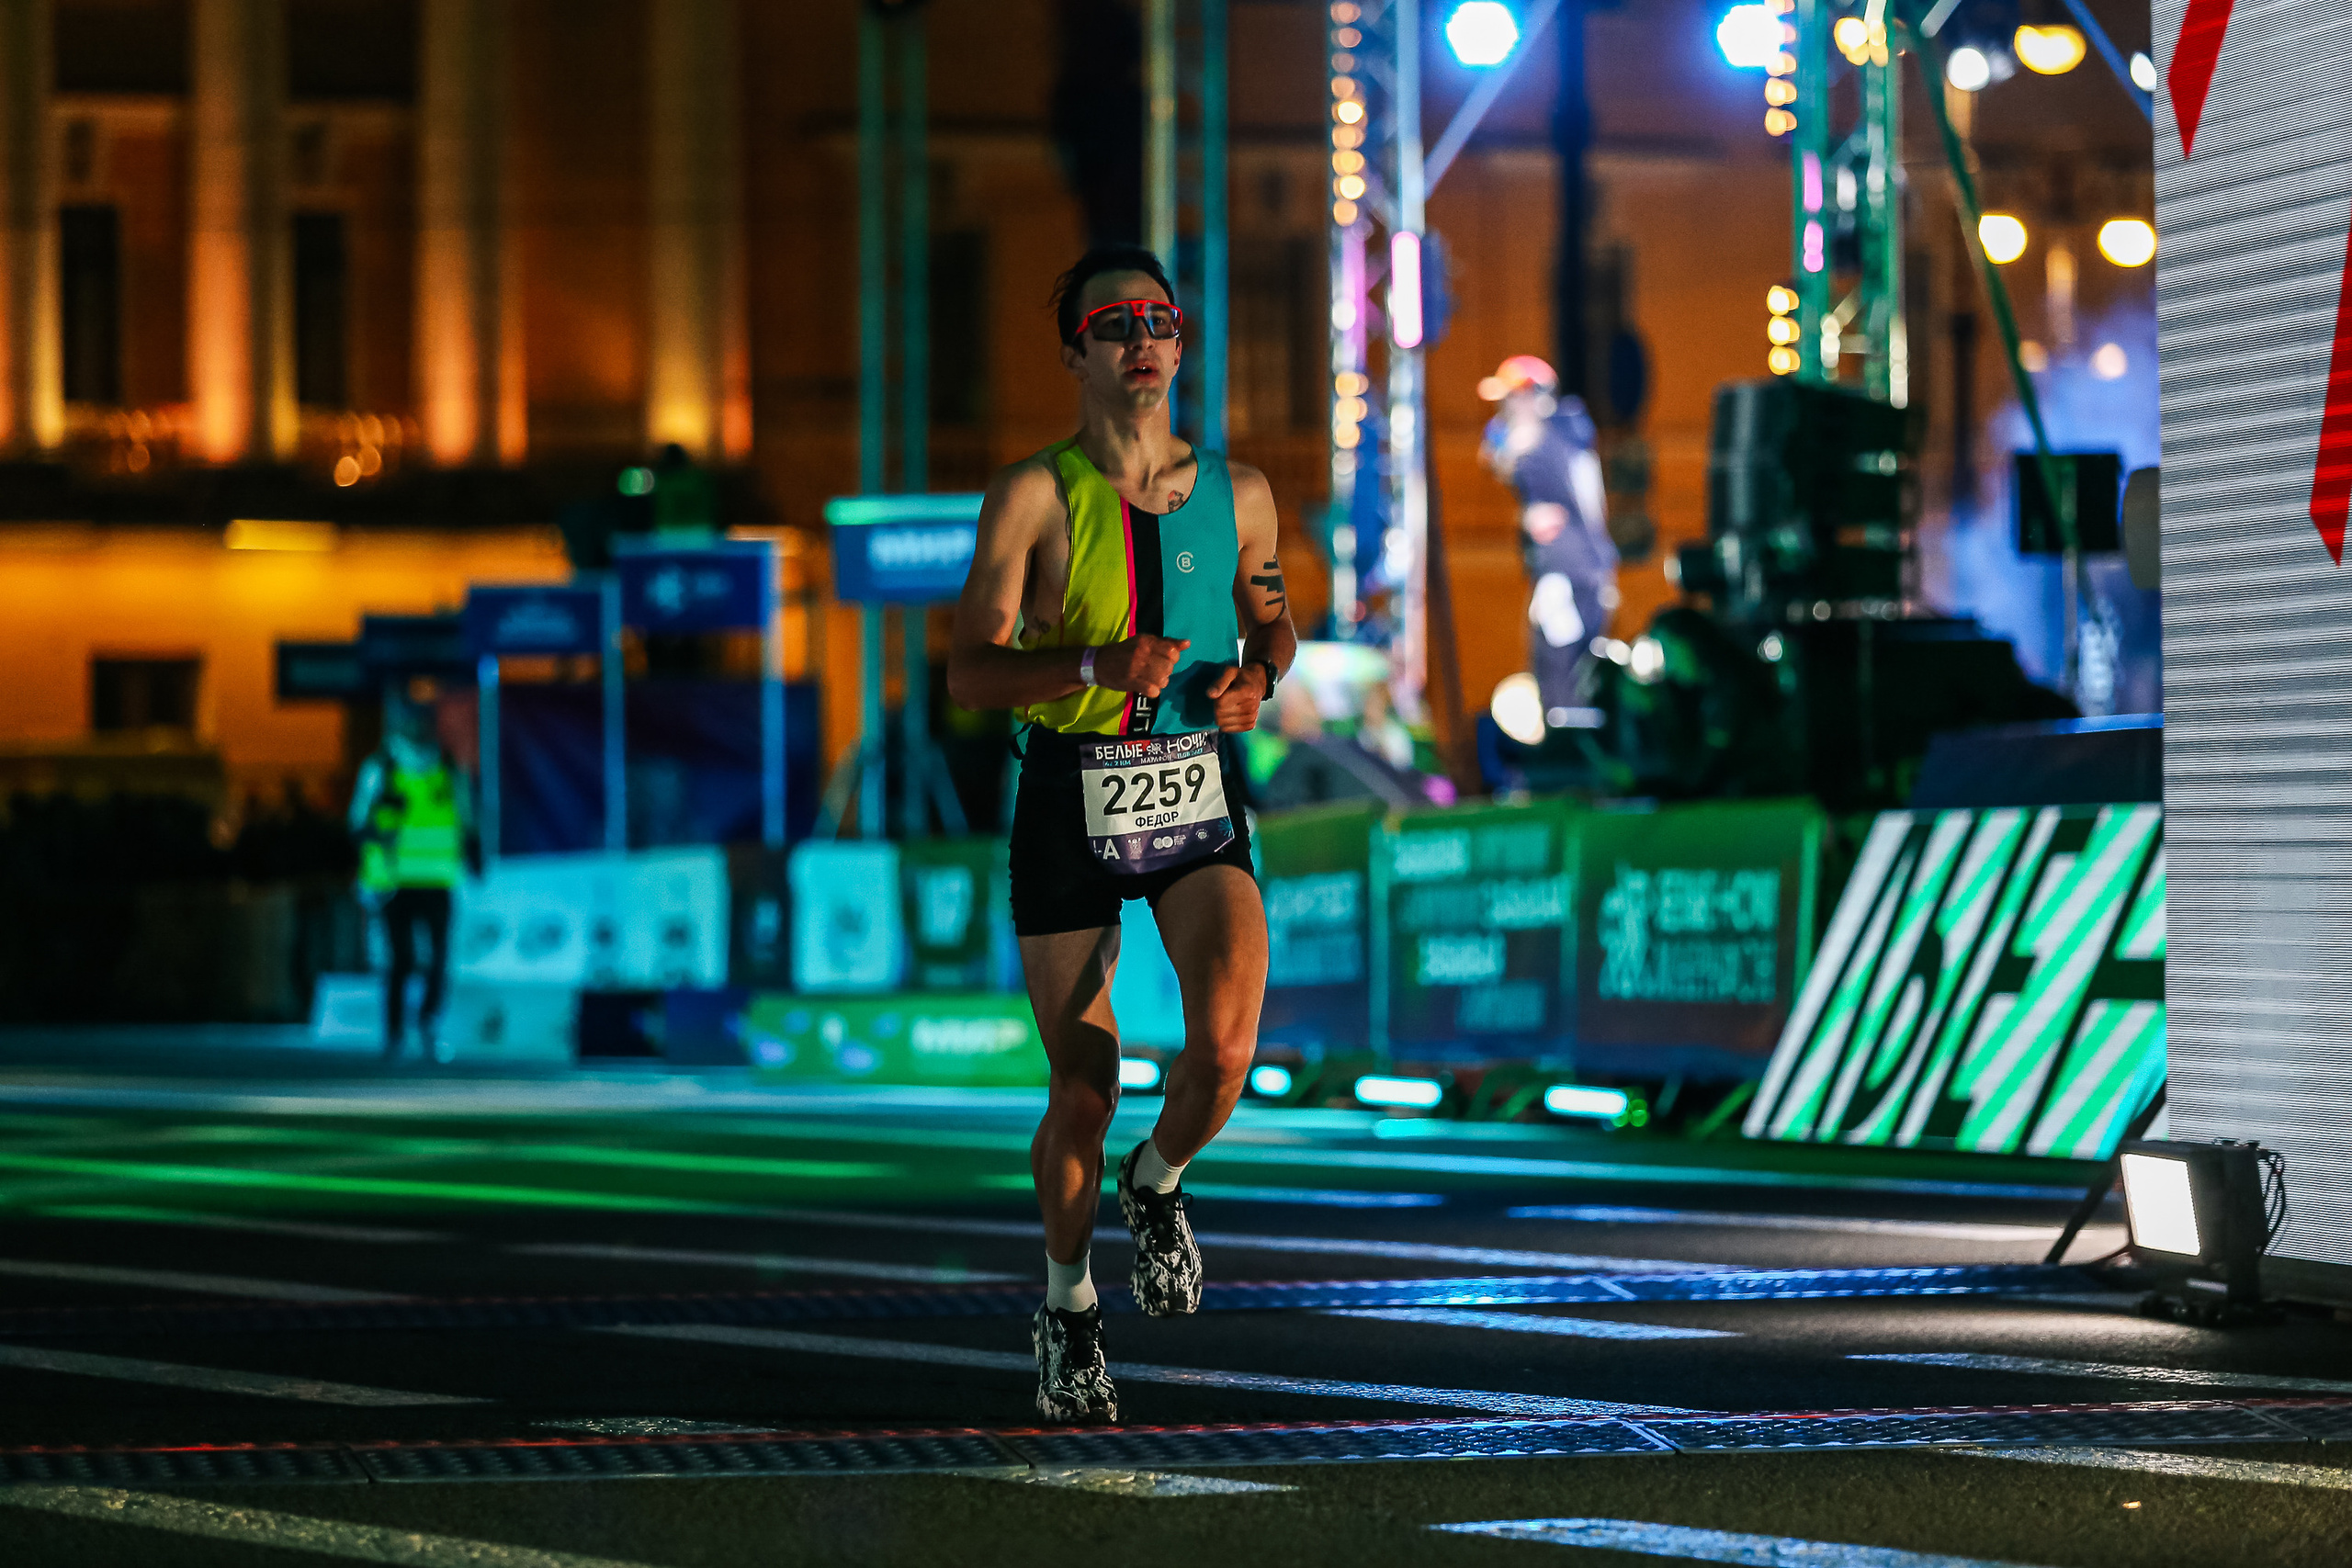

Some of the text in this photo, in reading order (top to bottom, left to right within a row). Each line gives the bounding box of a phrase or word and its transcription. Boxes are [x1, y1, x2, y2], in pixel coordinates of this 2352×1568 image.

[1133, 694, 1152, 733] LIF
[1094, 742, 1144, 761] БЕЛЫЕ
[1101, 763, 1206, 817] 2259
[1135, 811, 1180, 828] ФЕДОР
